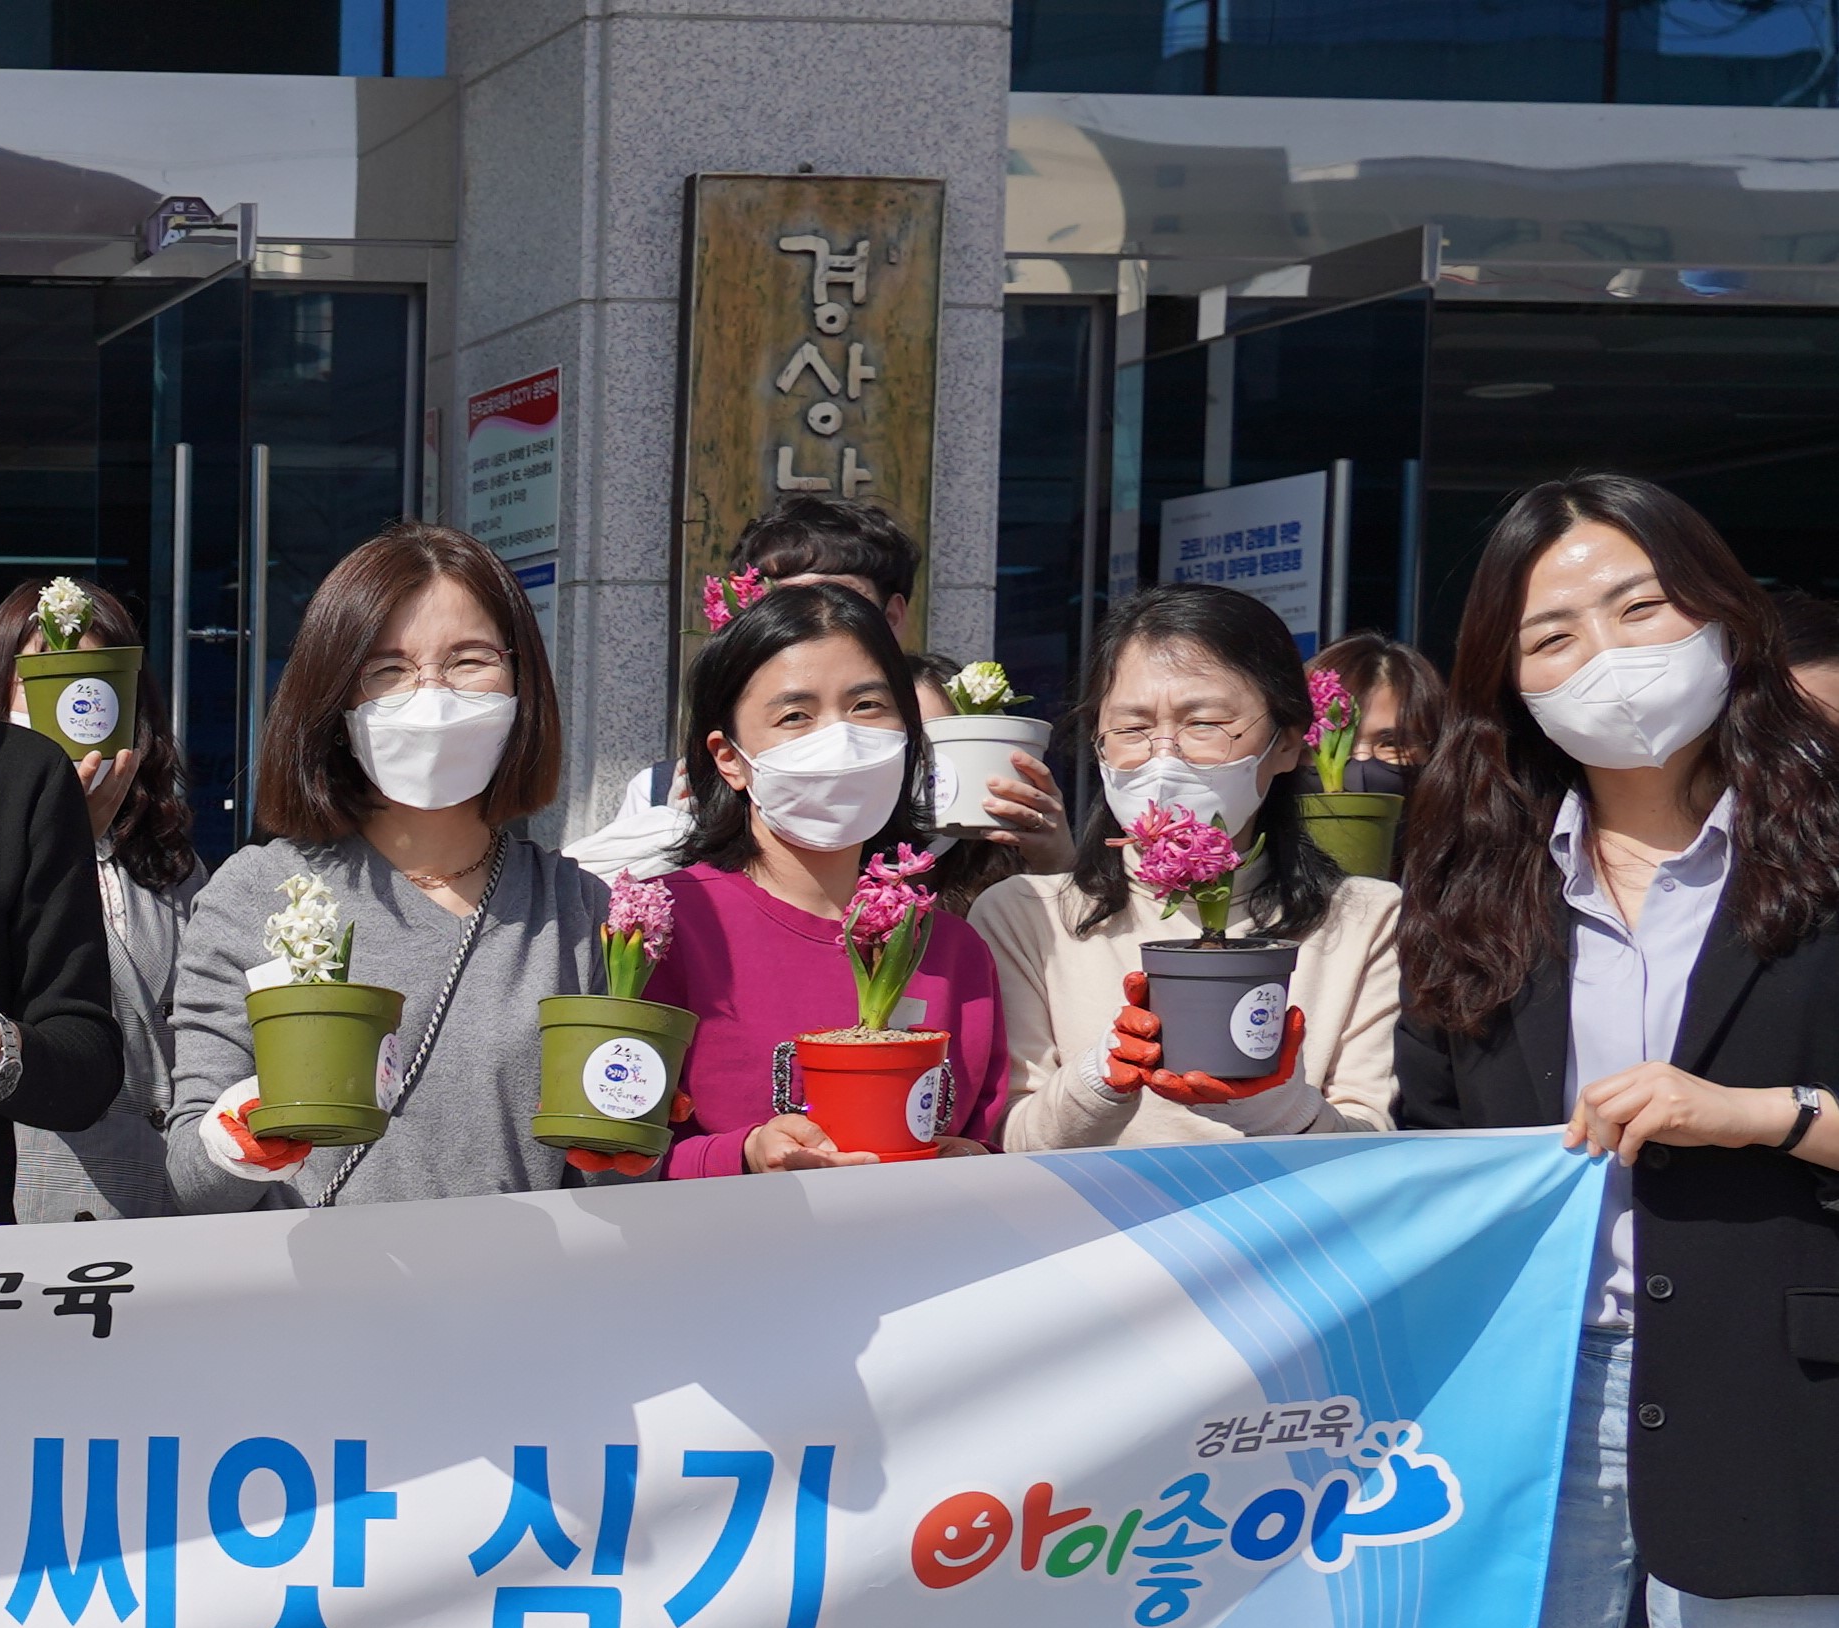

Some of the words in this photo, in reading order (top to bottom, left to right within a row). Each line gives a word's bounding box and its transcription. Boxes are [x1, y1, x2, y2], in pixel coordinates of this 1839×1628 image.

[1179, 535, 1221, 561] 코로나19
[1195, 1404, 1353, 1458] 경남교육
[911, 1472, 1452, 1627] 아이좋아
